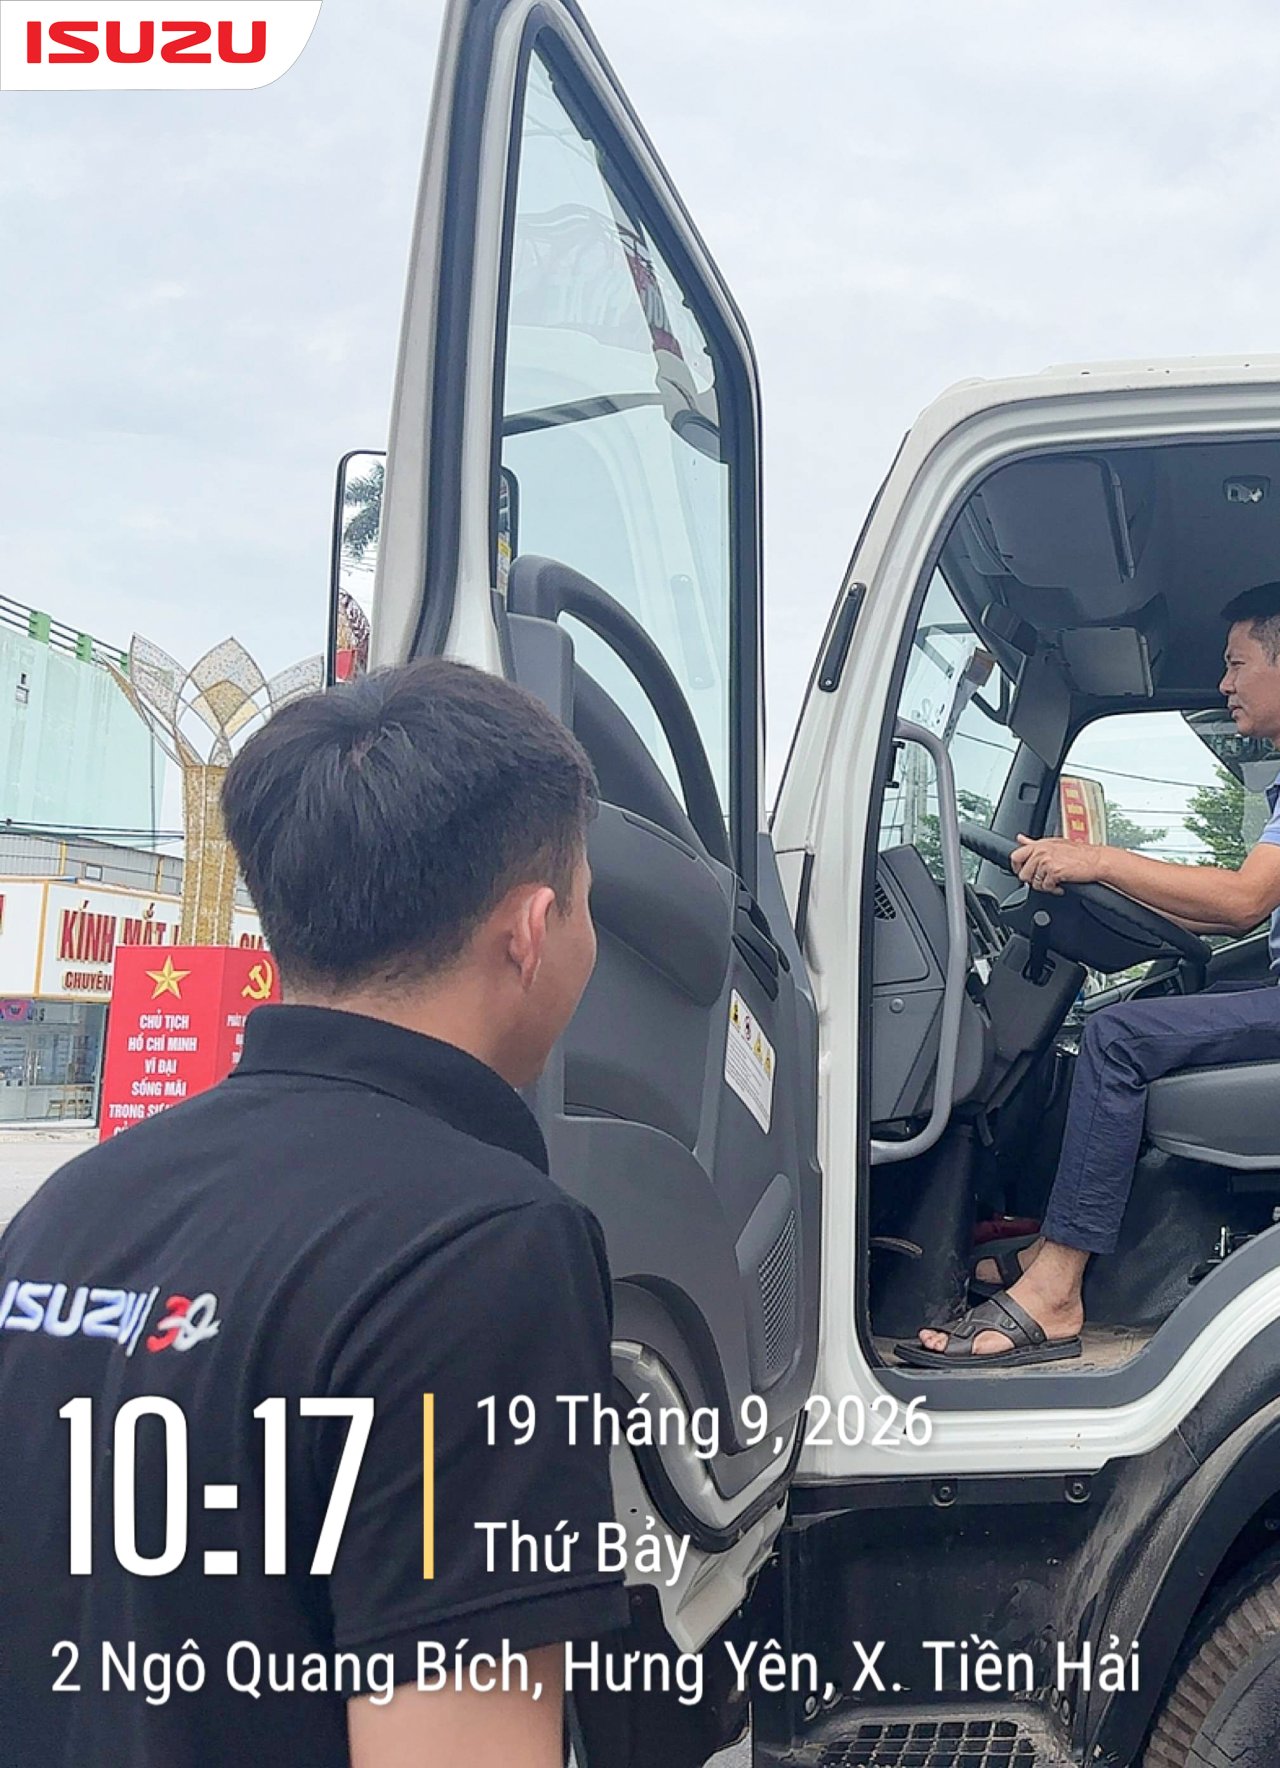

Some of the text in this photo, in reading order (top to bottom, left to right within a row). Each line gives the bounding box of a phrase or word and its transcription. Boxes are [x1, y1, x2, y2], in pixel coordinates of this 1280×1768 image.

[59, 900, 117, 963] KÍNH
[139, 1008, 190, 1032] CHỦ TỊCH
[146, 1034, 165, 1052] CHÍ
[166, 1037, 198, 1052] MINH
[157, 1058, 177, 1077] ĐẠI
[131, 1076, 162, 1096] SỐNG
[108, 1104, 146, 1119] TRONG
